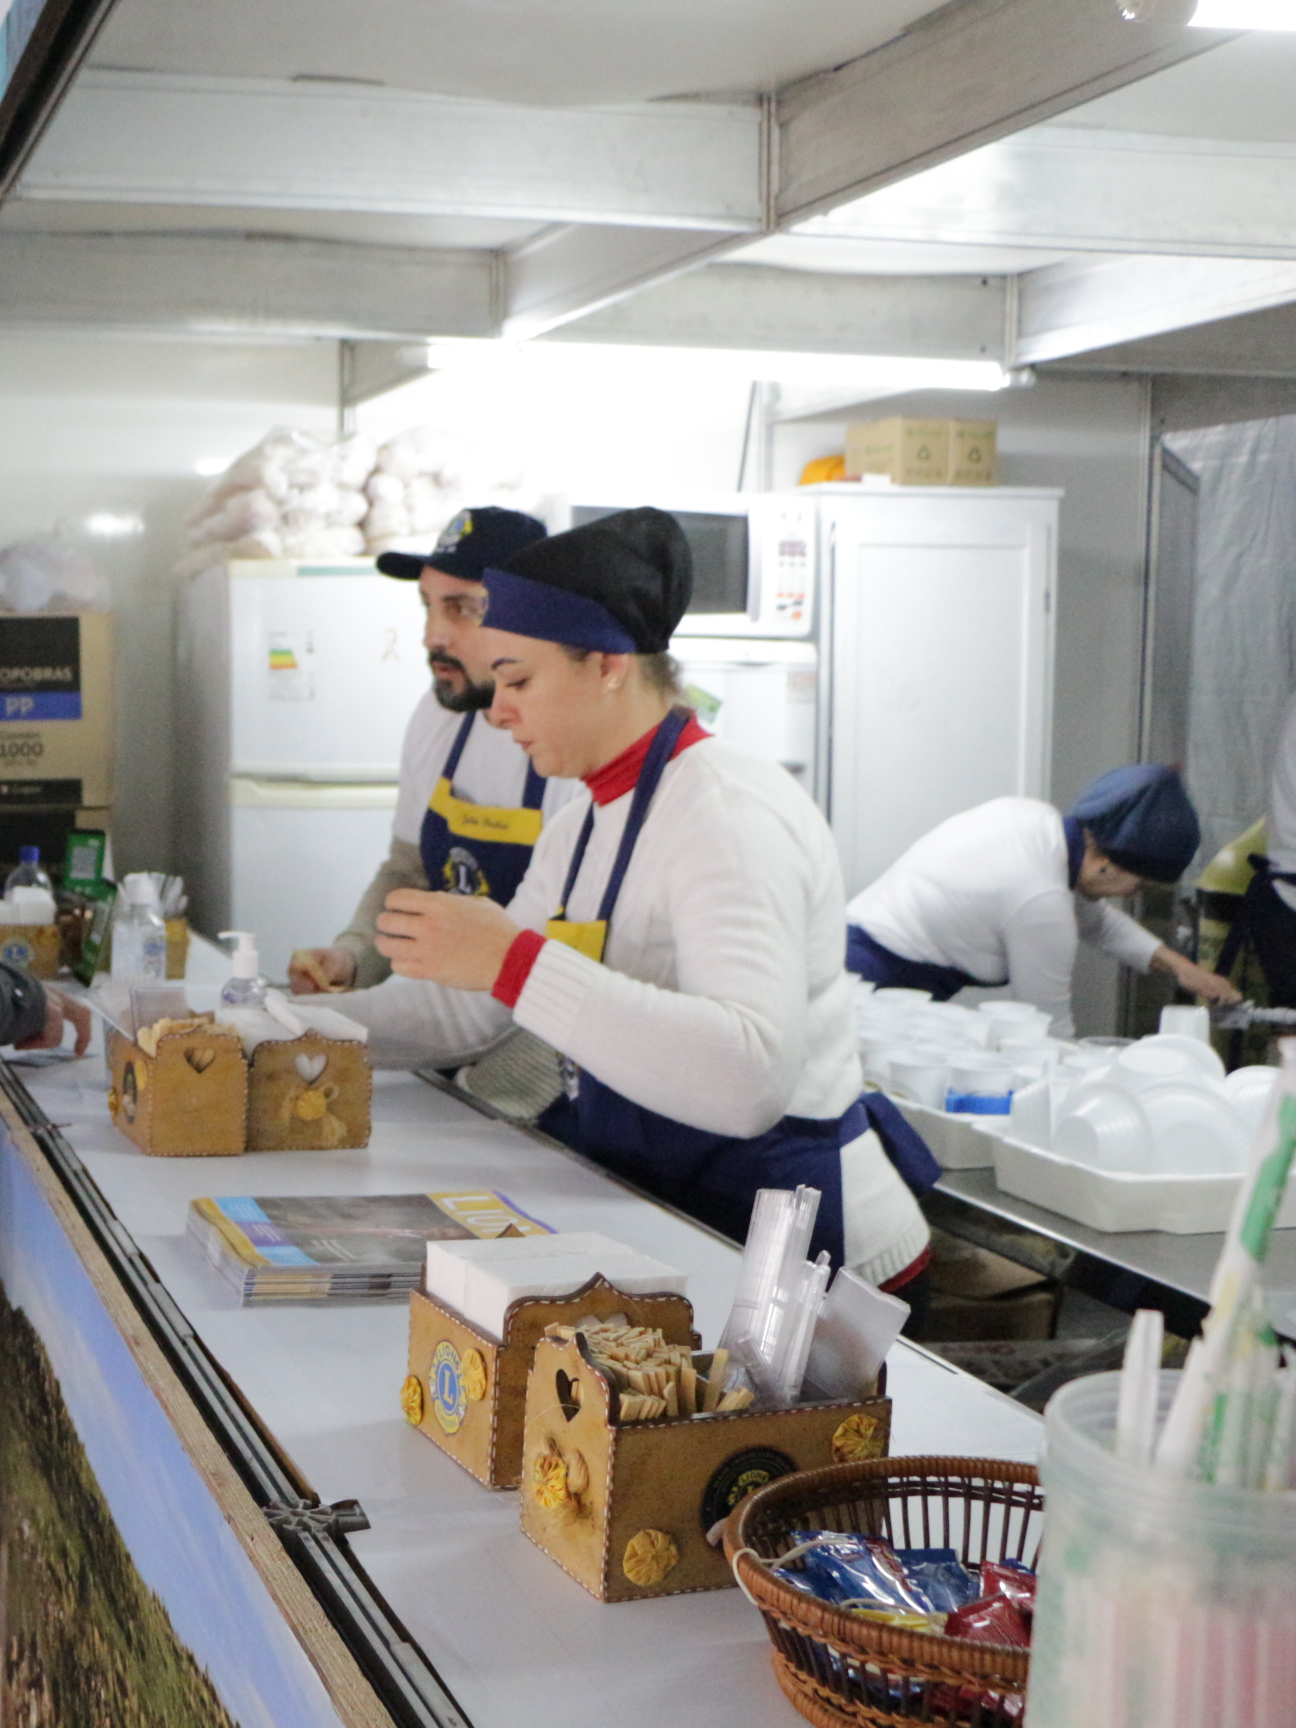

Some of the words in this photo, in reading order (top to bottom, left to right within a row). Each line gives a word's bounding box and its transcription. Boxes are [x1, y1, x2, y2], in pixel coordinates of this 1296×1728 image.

[5, 696, 35, 717] PP
[443, 1369, 454, 1405] L
[740, 1470, 770, 1484] LIONS
